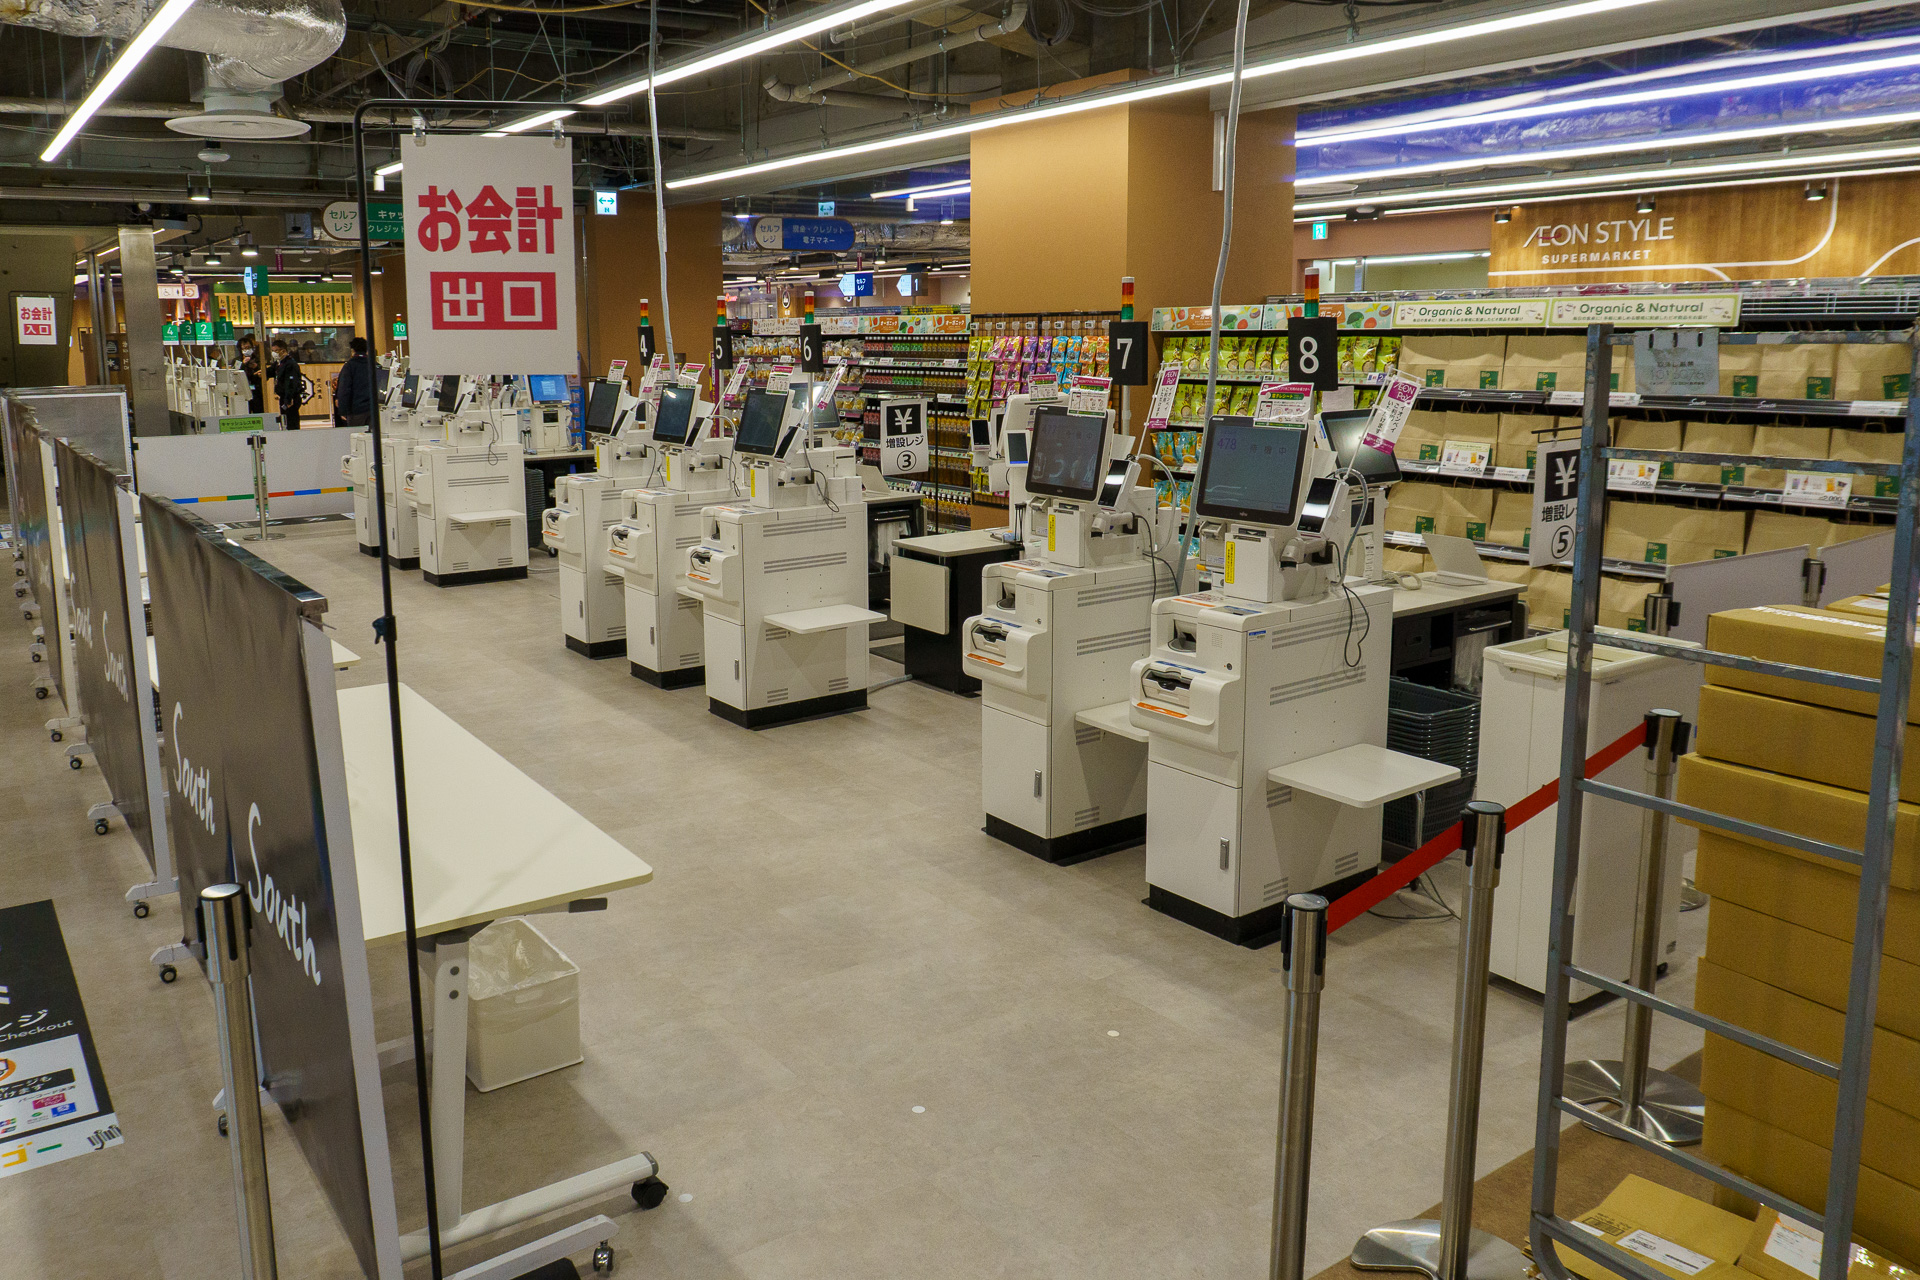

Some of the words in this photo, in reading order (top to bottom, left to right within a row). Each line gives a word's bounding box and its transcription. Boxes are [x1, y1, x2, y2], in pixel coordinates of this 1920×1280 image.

[329, 210, 358, 220] セルフ
[418, 185, 563, 254] お会計
[334, 222, 353, 232] レジ
[759, 225, 780, 233] セルフ
[1594, 217, 1675, 244] STYLE
[763, 235, 776, 243] レジ
[1542, 250, 1652, 265] SUPERMARKET
[914, 278, 919, 292] 1
[443, 278, 543, 322] 出口
[20, 307, 53, 321] お会計
[1418, 306, 1463, 317] Organic
[1464, 306, 1473, 315] &
[1475, 305, 1521, 315] Natural
[1580, 303, 1633, 315] Organic
[1636, 303, 1647, 313] &
[1649, 302, 1704, 313] Natural
[25, 325, 49, 335] 入口
[167, 327, 173, 335] 4
[185, 325, 192, 334] 3
[200, 324, 208, 334] 2
[222, 323, 227, 333] 1
[640, 340, 648, 358] 4
[715, 337, 723, 359] 5
[803, 338, 812, 361] 6
[1117, 338, 1134, 370] 7
[1299, 336, 1320, 374] 8
[1393, 381, 1416, 395] AEON
[894, 408, 914, 433] ¥
[886, 435, 925, 449] 増設レジ
[1555, 456, 1578, 497] ¥
[1541, 503, 1578, 523] 増設レ
[173, 701, 216, 836] South
[247, 802, 321, 986] South
